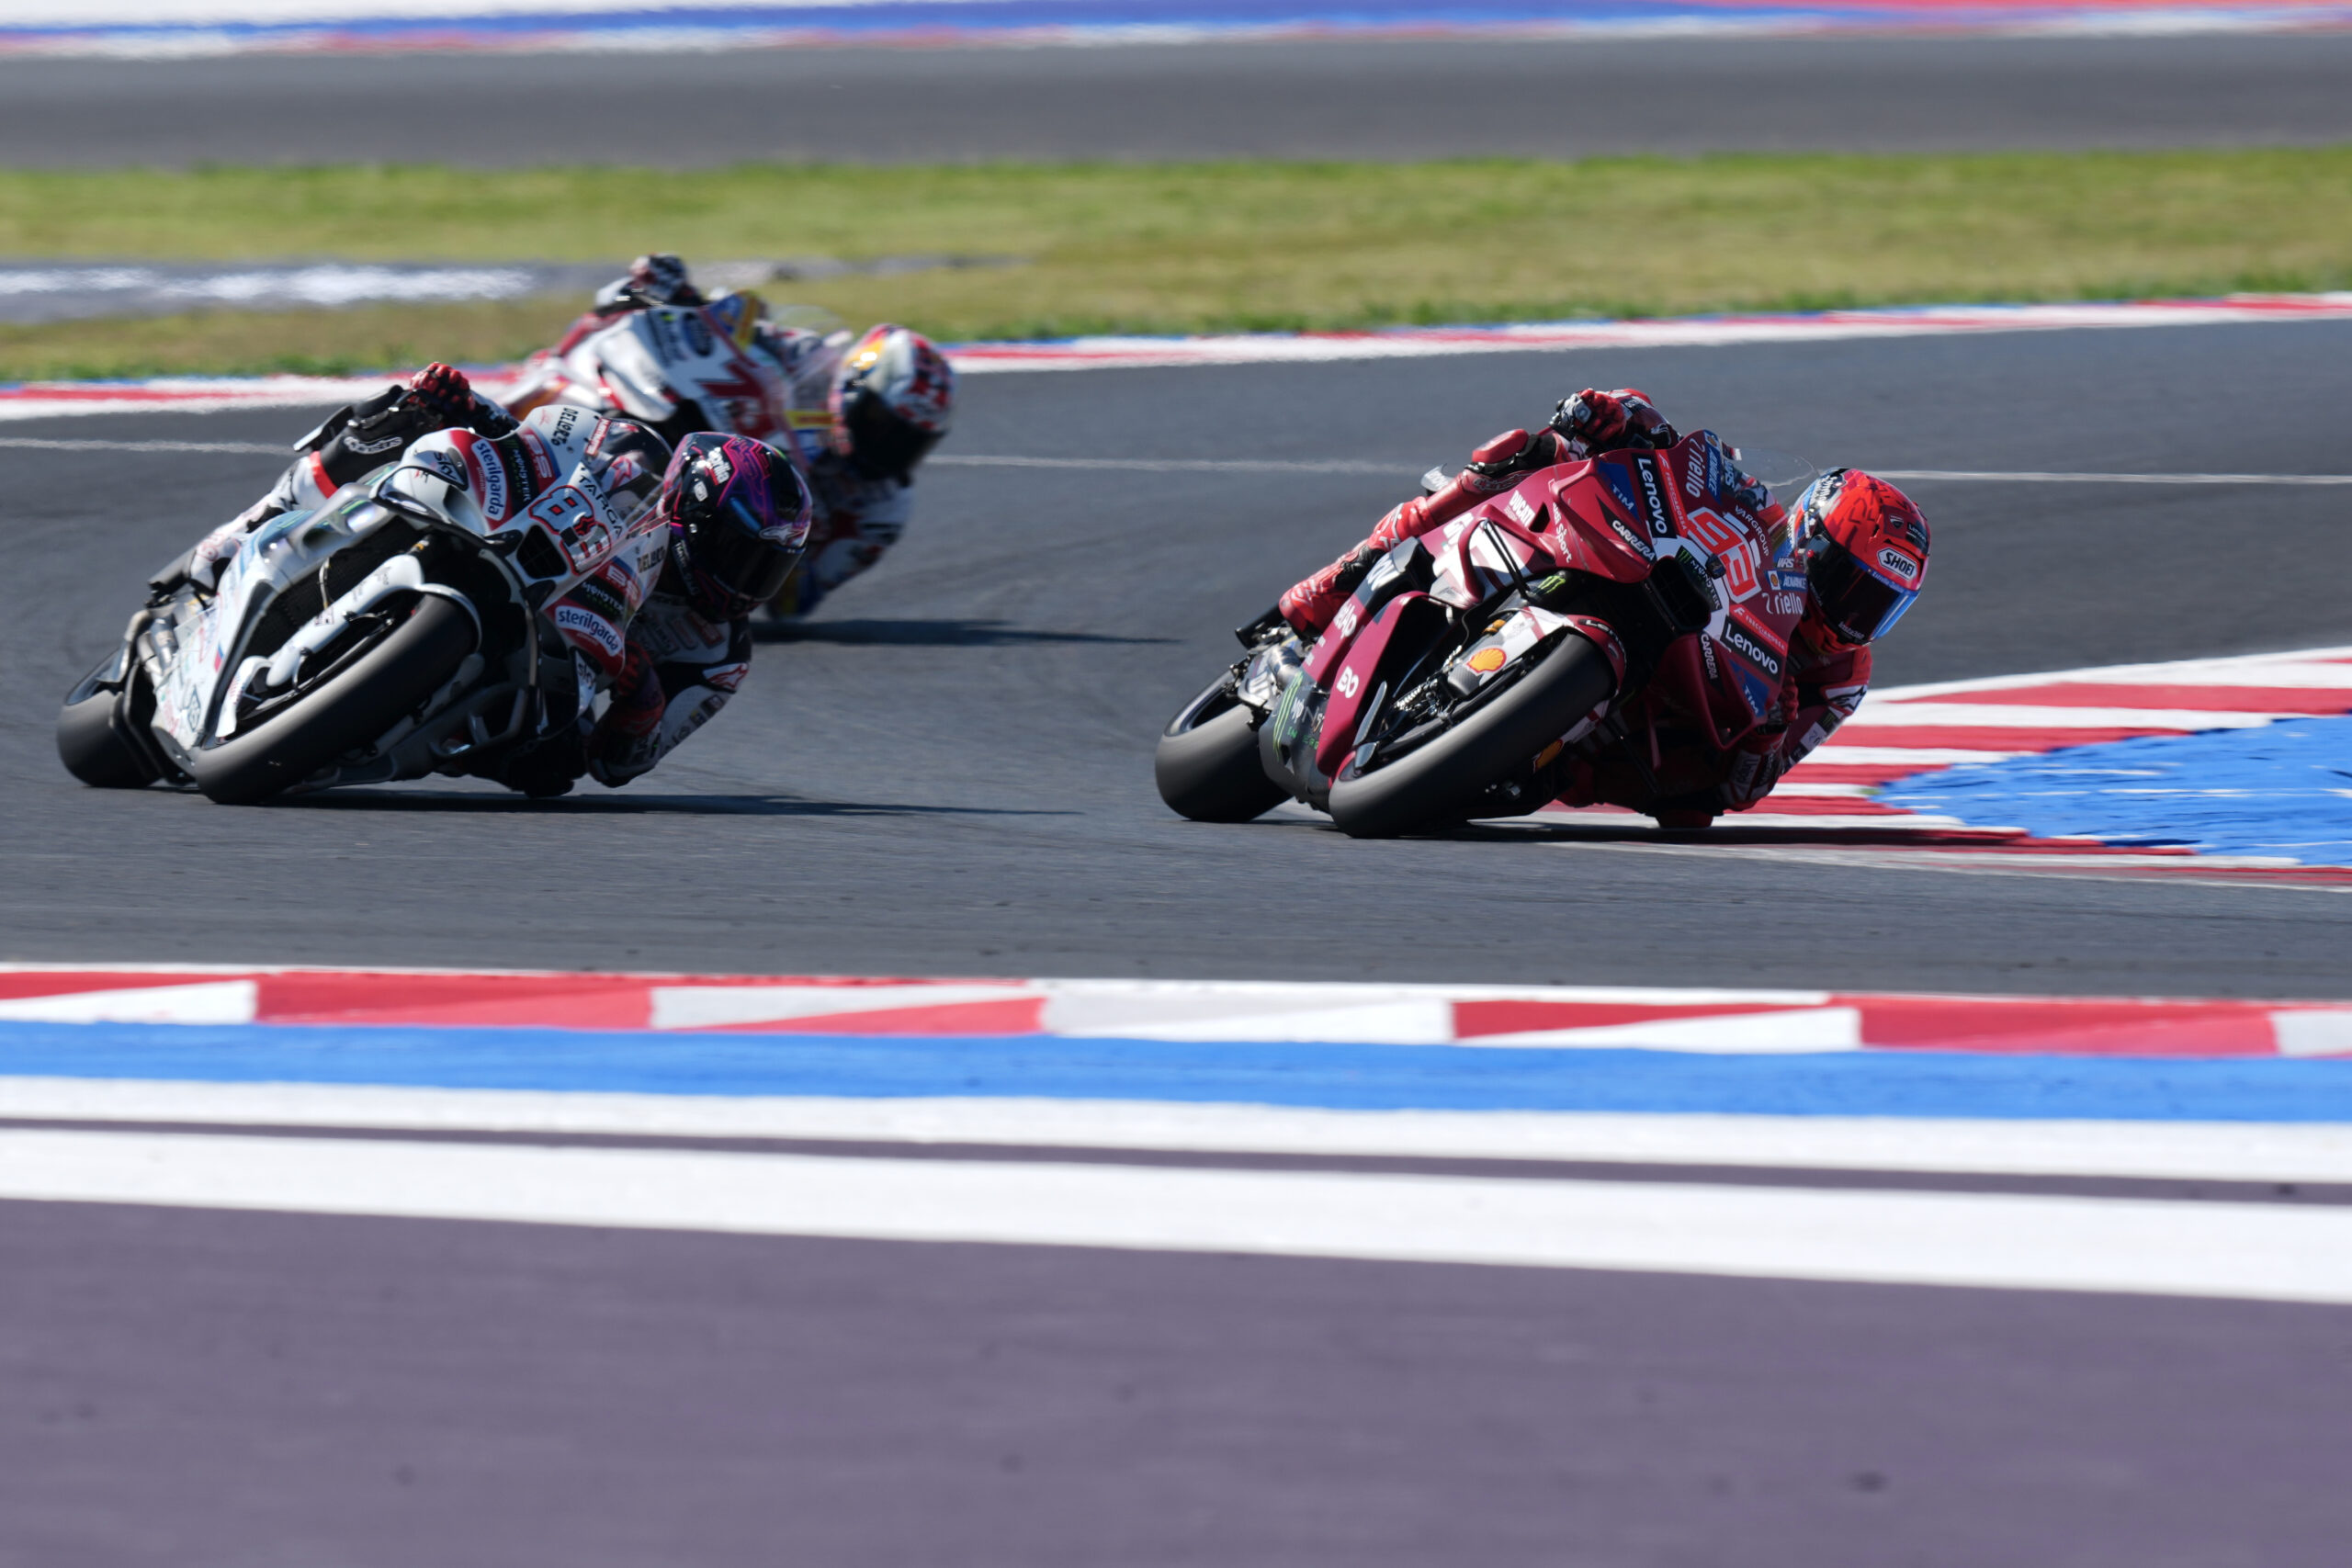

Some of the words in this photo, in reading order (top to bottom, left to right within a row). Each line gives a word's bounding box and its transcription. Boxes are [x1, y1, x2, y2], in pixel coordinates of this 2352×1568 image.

[476, 442, 503, 515] sterilgarda
[1638, 457, 1668, 534] Lenovo
[1686, 451, 1706, 498] riello
[579, 475, 622, 538] TARGA
[1509, 490, 1536, 527] DUCATI
[1611, 484, 1635, 510] TIM
[1556, 524, 1573, 563] Sport
[1611, 518, 1657, 561] CARRERA
[1735, 505, 1770, 557] VARGROUP
[1690, 508, 1760, 601] 93
[1883, 551, 1916, 577] SHOEI
[1690, 559, 1722, 609] MONSTER
[1775, 592, 1803, 615] riello
[559, 610, 618, 649] sterilgarda
[1725, 623, 1779, 674] Lenovo
[1746, 615, 1785, 650] FRECCIAROSSA
[1701, 634, 1718, 679] CARRERA
[1744, 685, 1759, 714] TIM
